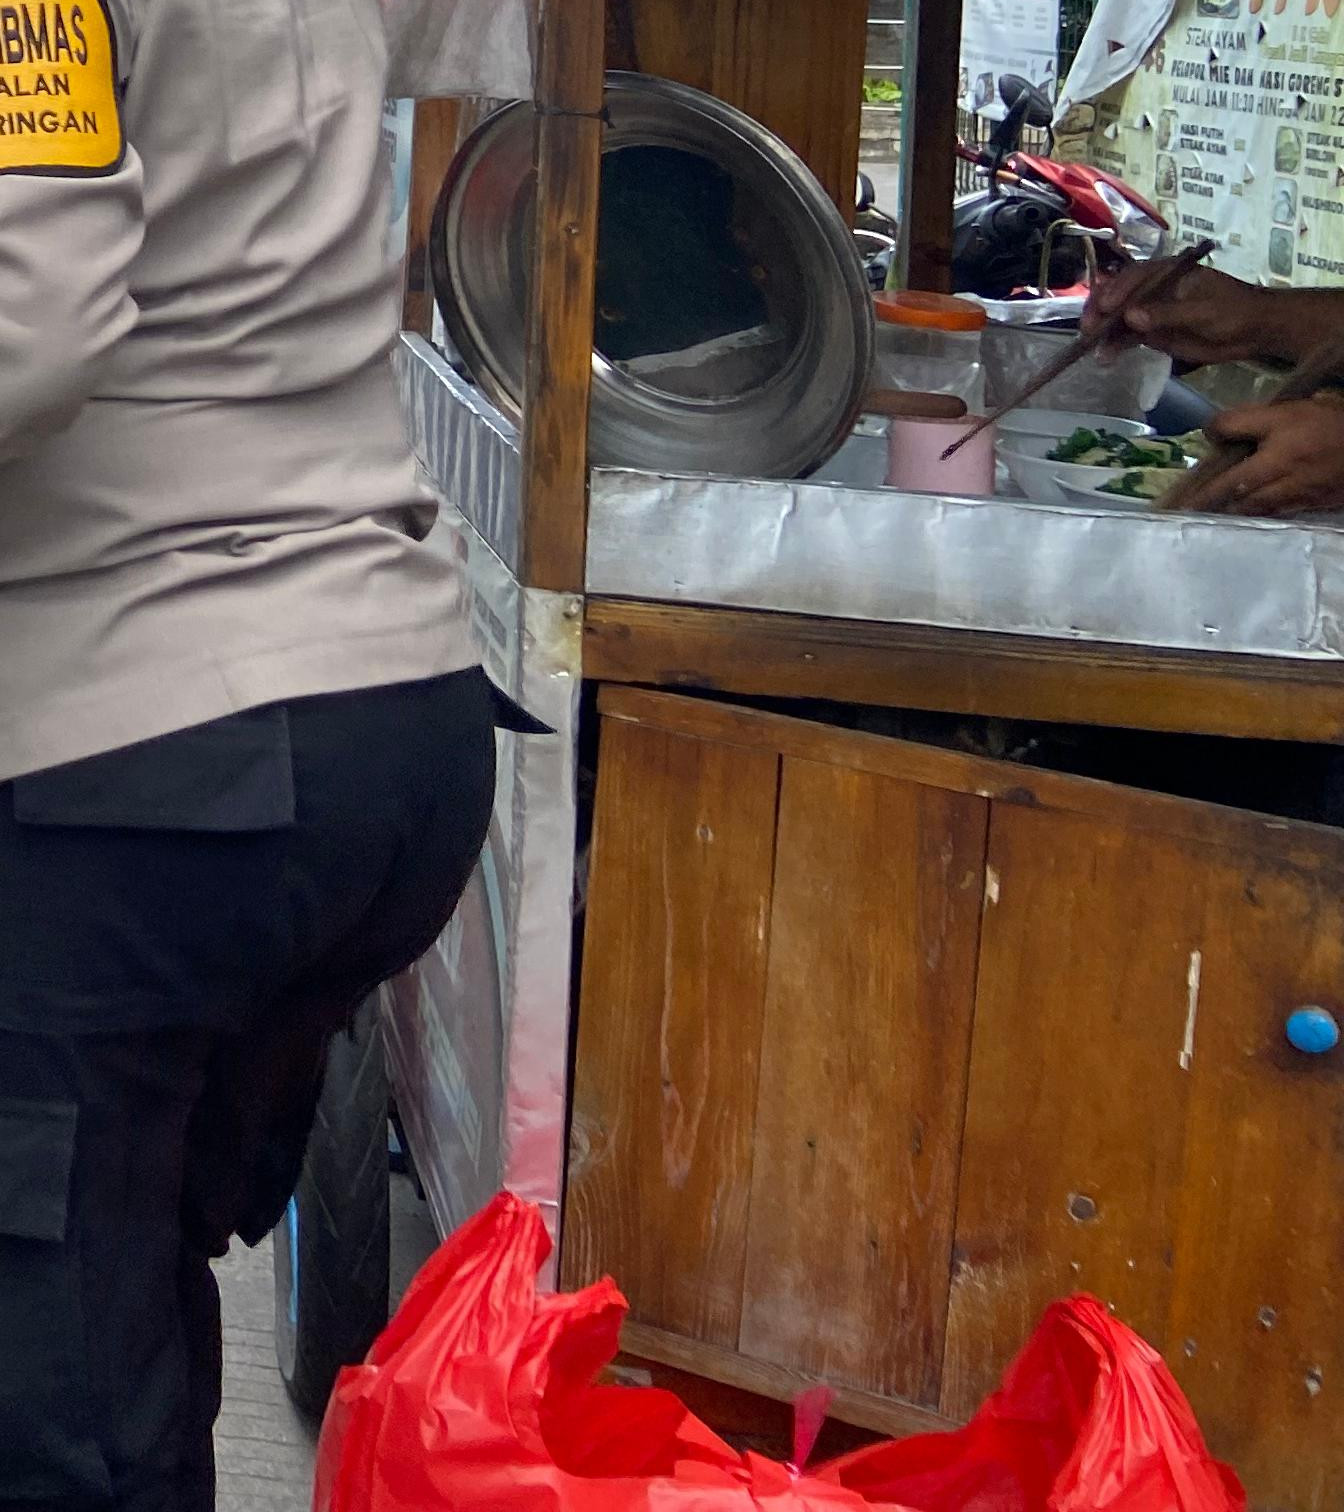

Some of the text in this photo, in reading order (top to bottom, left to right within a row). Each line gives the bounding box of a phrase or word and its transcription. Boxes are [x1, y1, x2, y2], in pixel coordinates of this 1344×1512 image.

[1214, 31, 1248, 51] AYAM
[1259, 70, 1286, 92] NASI
[1288, 73, 1332, 97] GORENG
[1204, 91, 1228, 111] JAM
